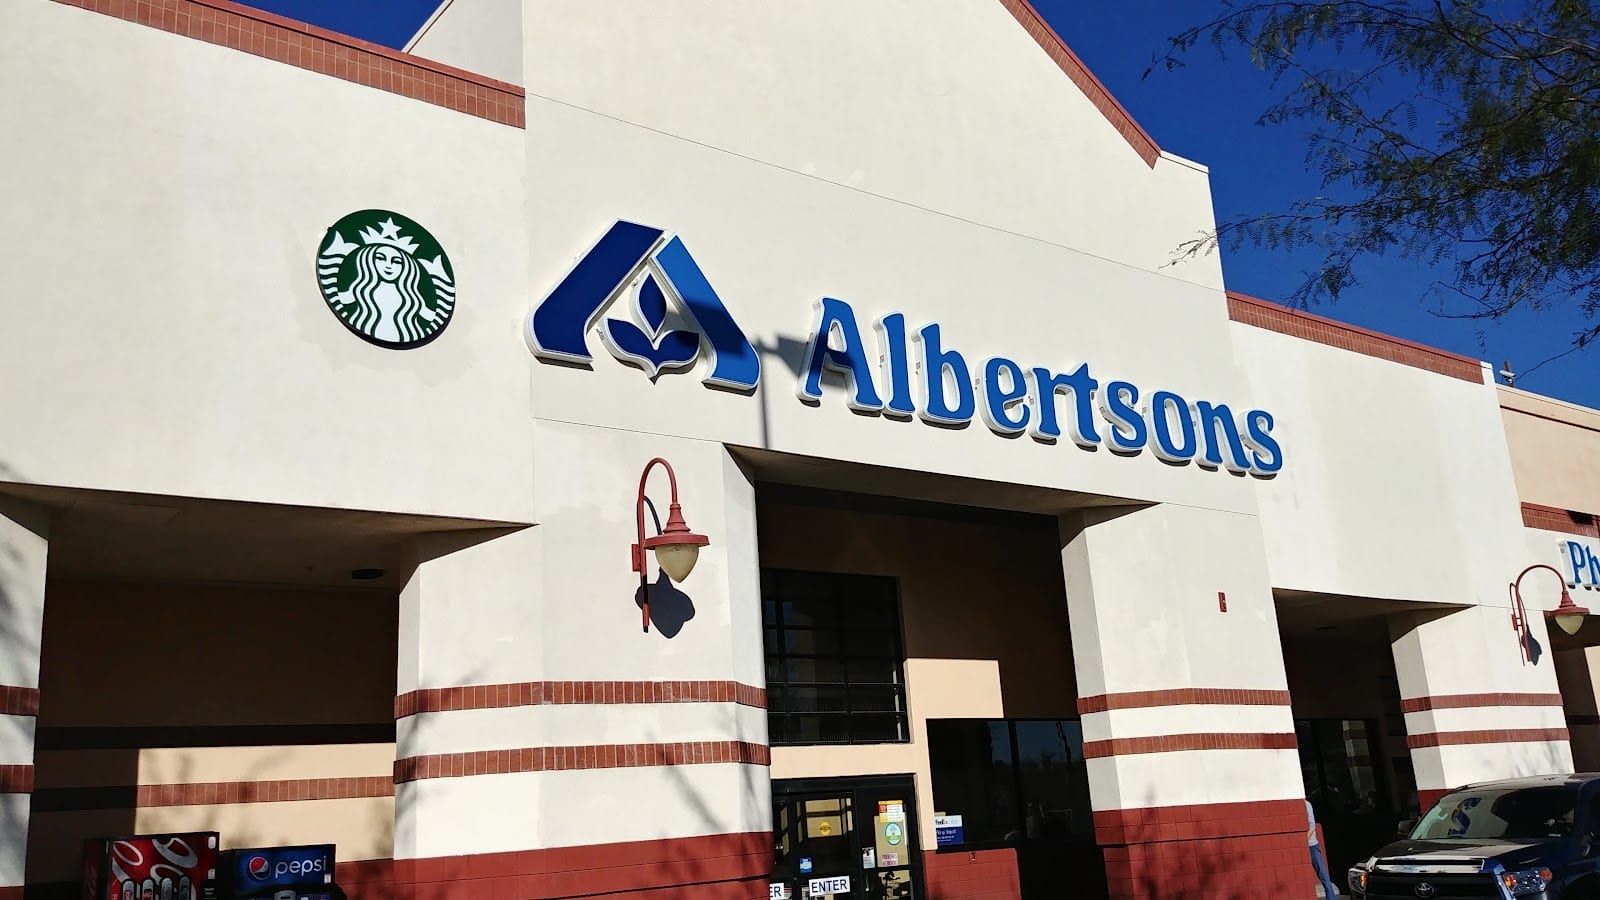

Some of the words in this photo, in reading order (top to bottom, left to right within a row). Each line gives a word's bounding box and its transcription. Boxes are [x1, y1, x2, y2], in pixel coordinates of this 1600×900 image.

[801, 297, 1283, 473] Albertsons
[275, 855, 327, 879] pepsi
[811, 879, 848, 893] ENTER
